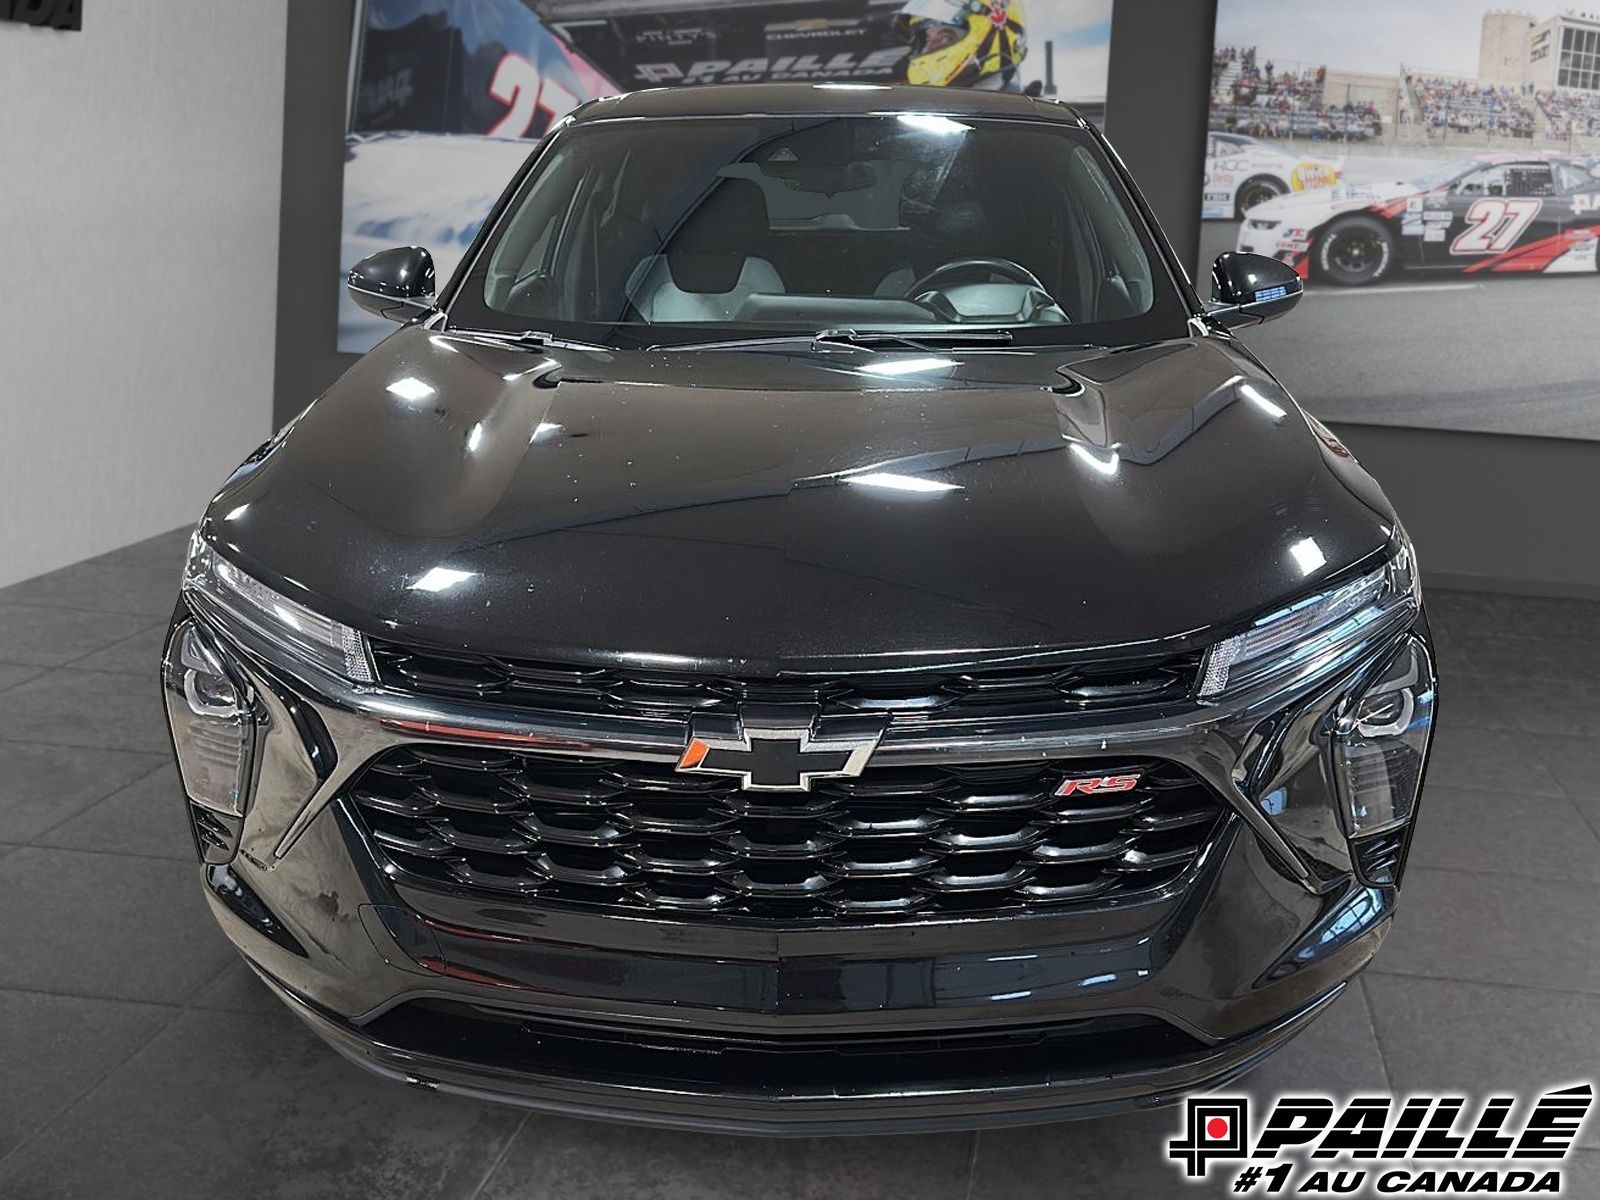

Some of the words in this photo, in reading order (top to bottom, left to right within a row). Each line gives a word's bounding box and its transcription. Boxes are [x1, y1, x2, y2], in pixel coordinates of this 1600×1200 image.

[766, 29, 865, 40] CHEVROLET
[771, 67, 893, 79] CANADA
[484, 51, 581, 139] 27
[1449, 197, 1543, 255] 27
[1054, 774, 1141, 796] RS
